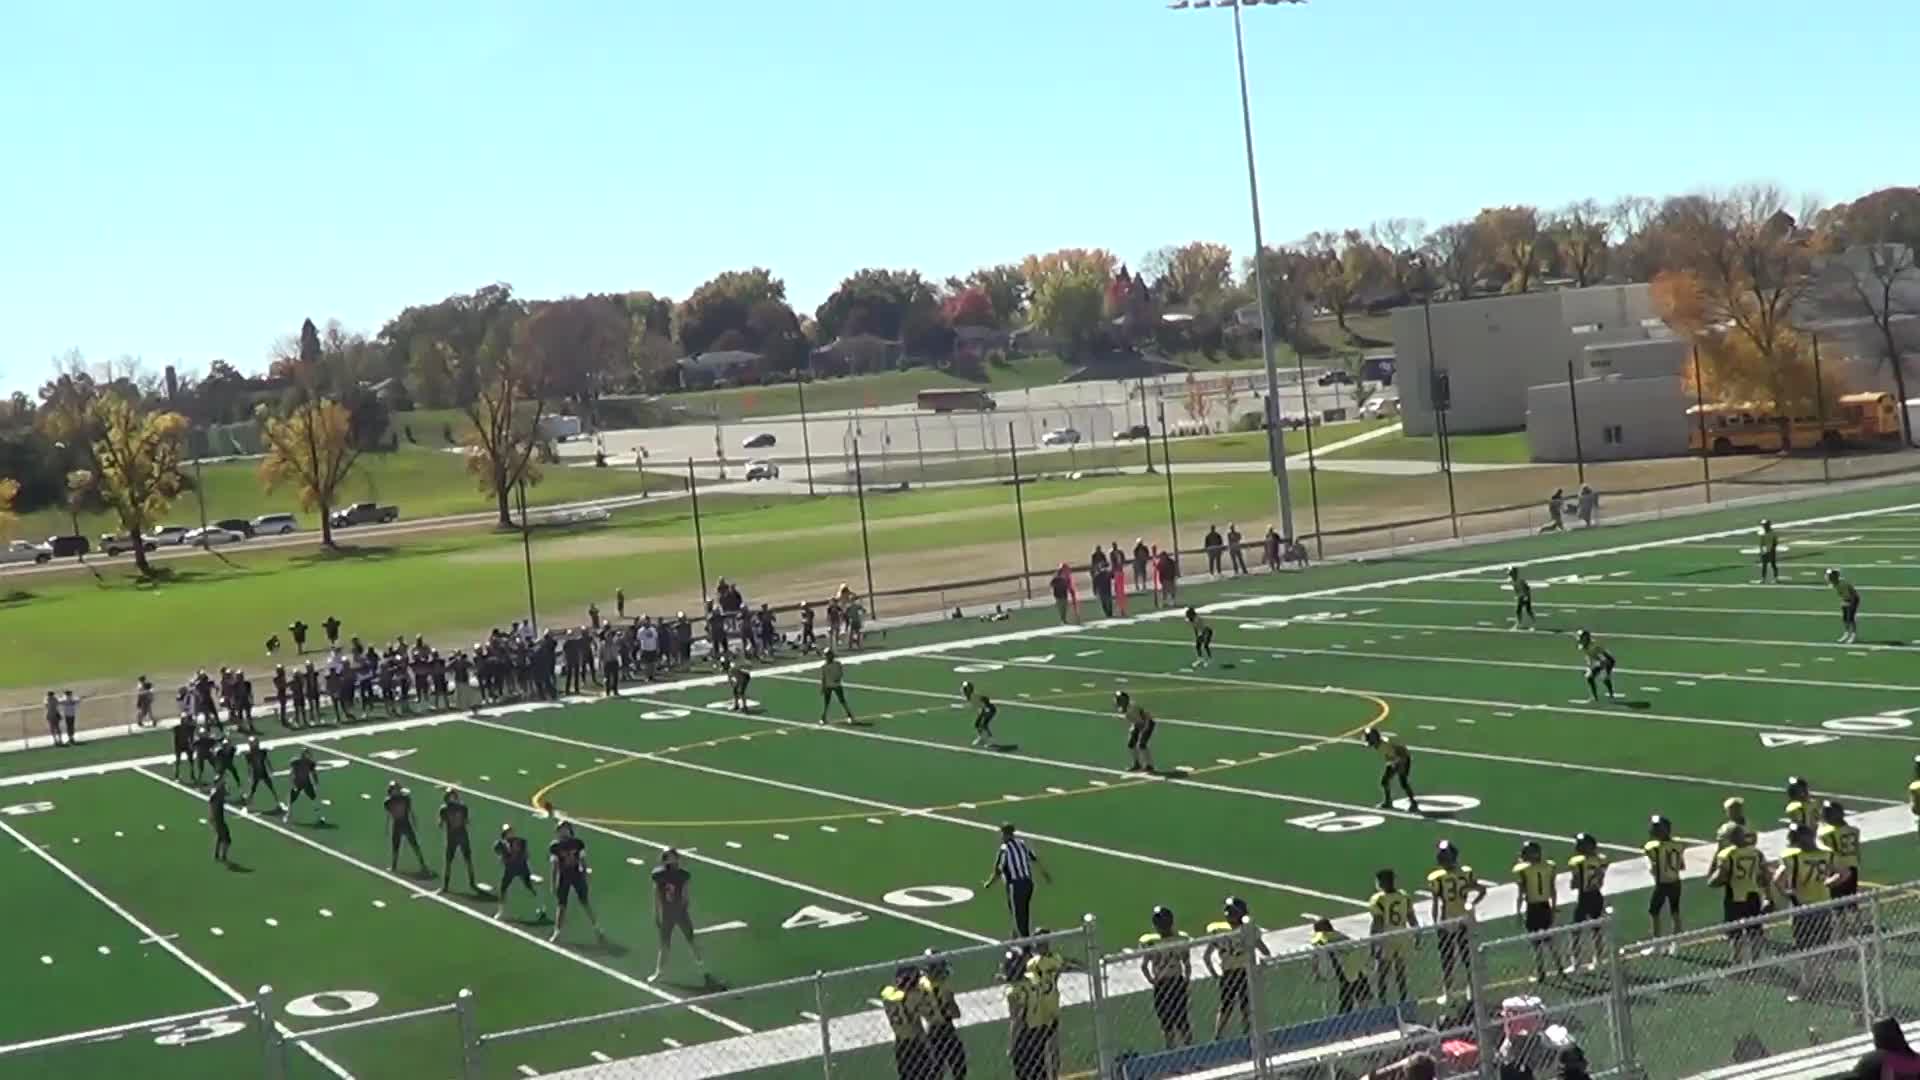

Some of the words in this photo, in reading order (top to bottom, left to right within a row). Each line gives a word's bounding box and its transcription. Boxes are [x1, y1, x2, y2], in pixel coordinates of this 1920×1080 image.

[1759, 716, 1913, 747] 40
[1284, 795, 1481, 832] 50
[1736, 855, 1757, 880] 57
[1536, 871, 1543, 896] 1
[781, 885, 975, 929] 40
